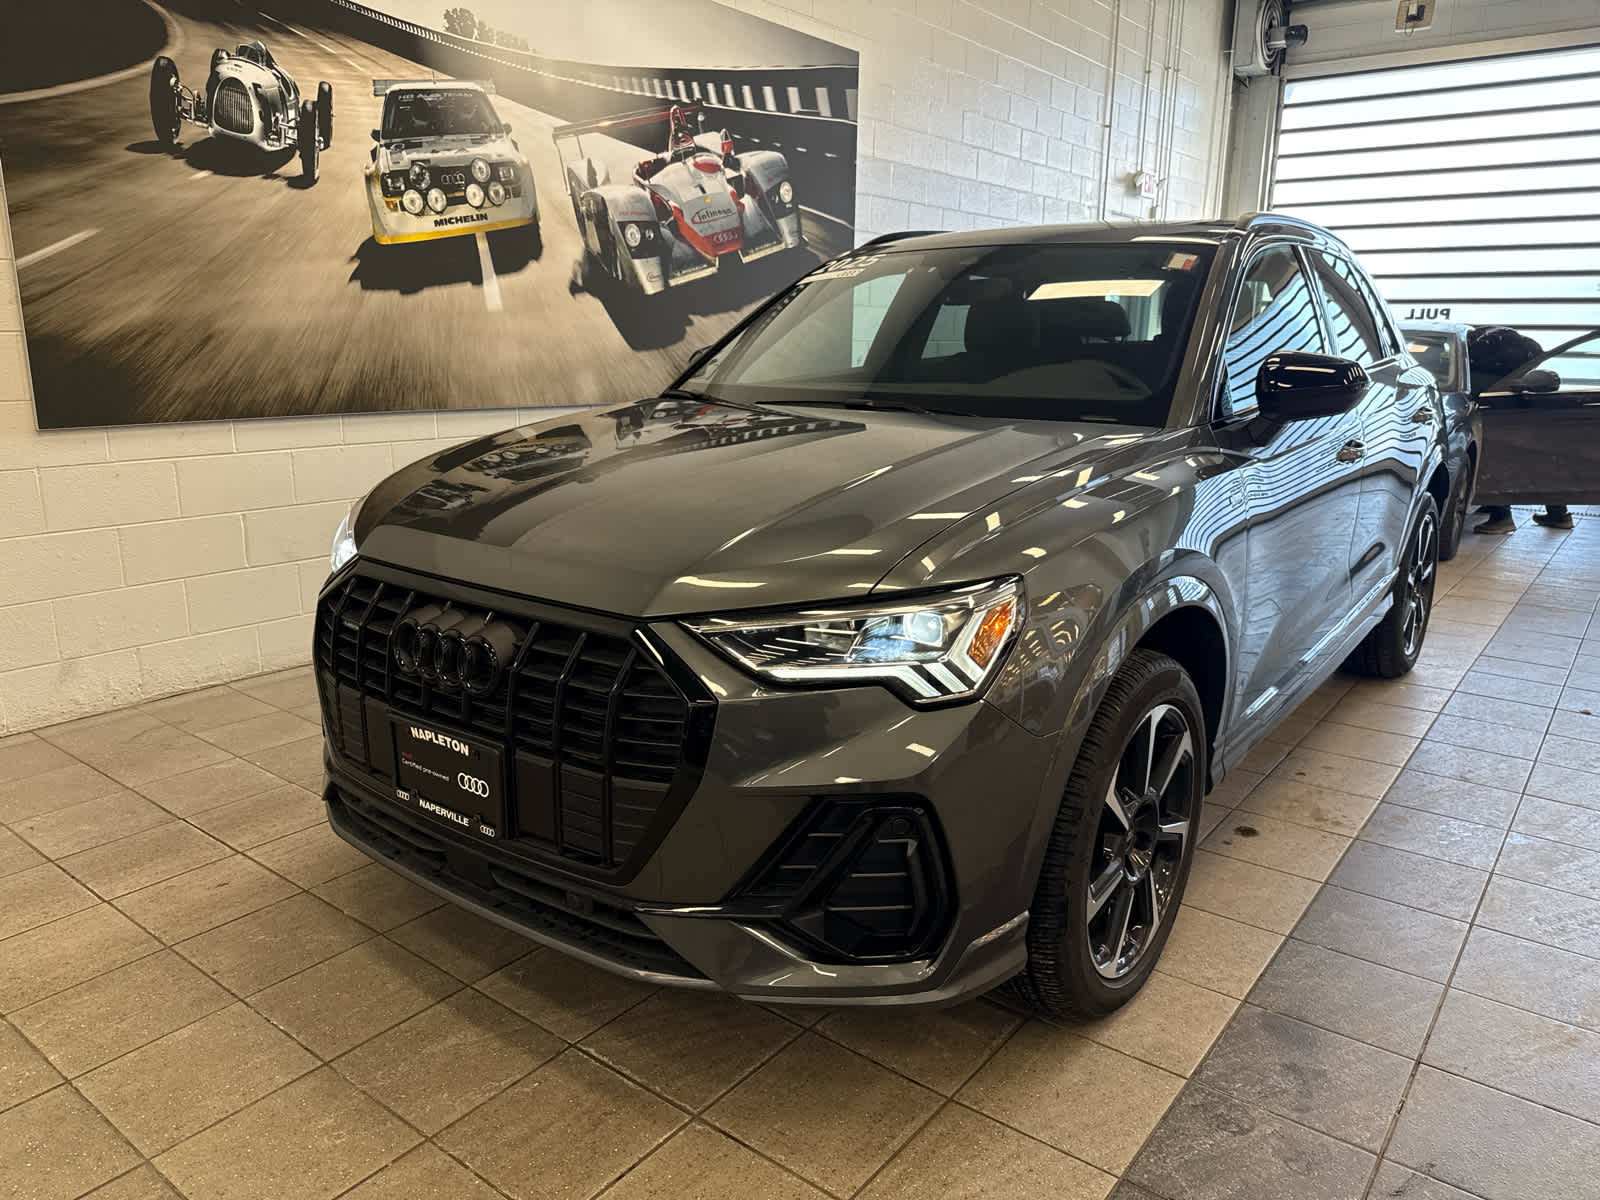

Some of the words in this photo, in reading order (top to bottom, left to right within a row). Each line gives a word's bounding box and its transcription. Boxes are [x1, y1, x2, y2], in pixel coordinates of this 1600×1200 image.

[434, 213, 488, 227] MICHELIN
[410, 726, 469, 756] NAPLETON
[419, 799, 470, 827] NAPERVILLE
